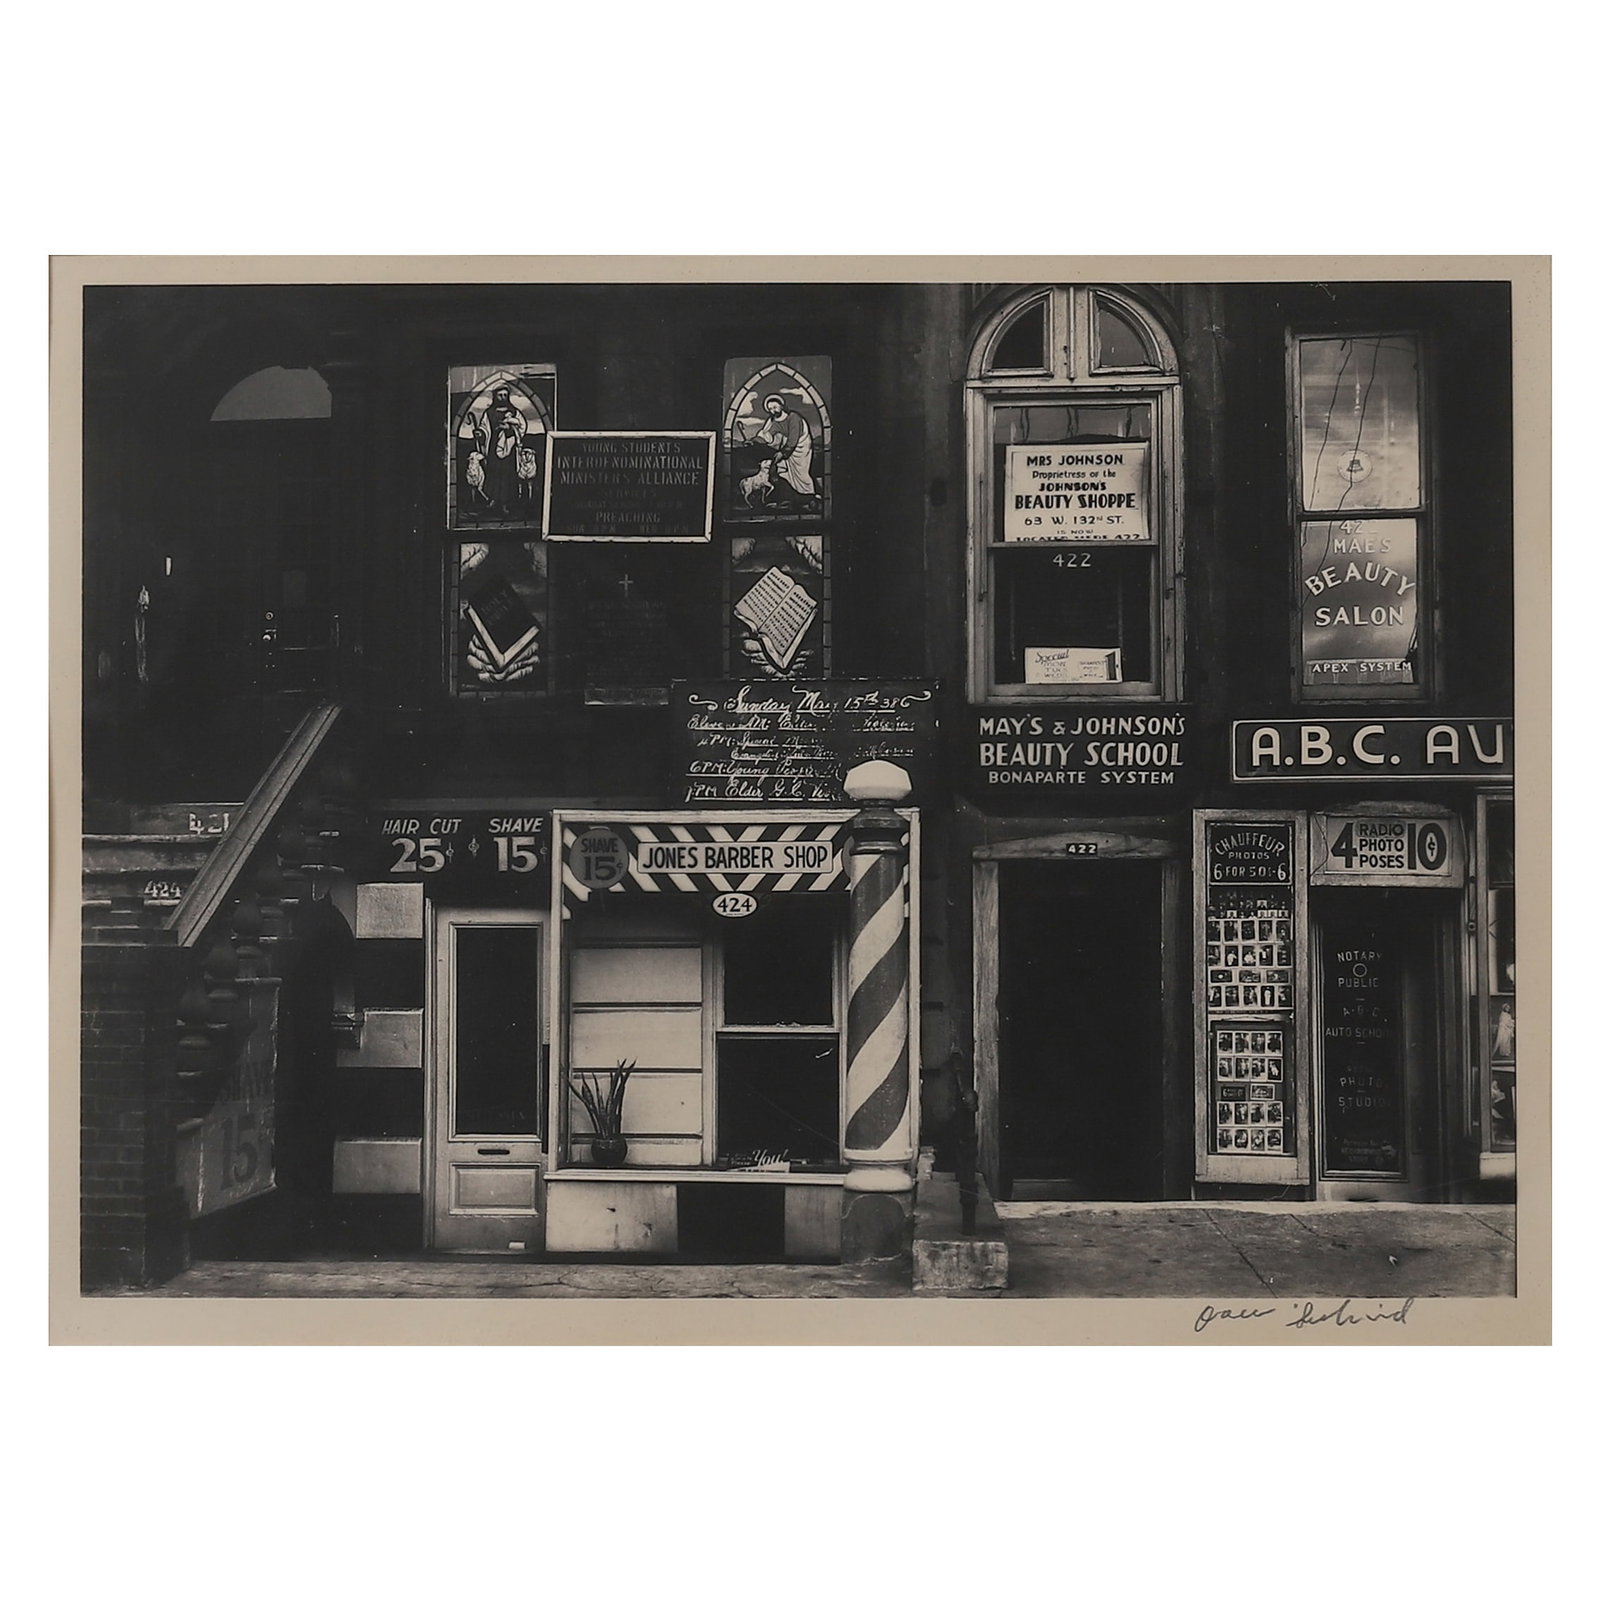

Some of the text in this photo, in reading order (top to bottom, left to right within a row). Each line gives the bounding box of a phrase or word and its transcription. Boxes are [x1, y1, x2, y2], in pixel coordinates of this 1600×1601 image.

[582, 441, 681, 453] YOUNG STUDENTS
[1027, 454, 1123, 466] MRS JOHNSON
[638, 471, 700, 485] ALLIANCE
[1032, 468, 1116, 481] Proprietress of the
[1015, 492, 1136, 509] BEAUTY SHOPPE
[596, 512, 660, 523] PREACHING
[1024, 515, 1043, 526] 63
[1051, 515, 1067, 525] W.
[1052, 552, 1092, 568] 422
[1304, 562, 1416, 597] BEAUTY
[1314, 605, 1404, 626] SALON
[1312, 661, 1413, 673] APEX SYSTEM
[724, 684, 791, 715] Sunday
[979, 712, 1185, 736] MAY'S & JOHNSON'S
[1251, 724, 1401, 767] A.B.C.
[979, 741, 1184, 767] BEAUTY SCHOOL
[988, 770, 1176, 785] BONAPARTE SYSTEM
[381, 819, 463, 835] HAIR CUT
[488, 817, 545, 834] SHAVE
[1359, 824, 1405, 837] RADIO
[580, 838, 619, 853] SHAVE
[1066, 843, 1098, 855] 422
[1214, 832, 1286, 857] CHAUFFEUR
[1330, 822, 1359, 869] 4
[1359, 839, 1405, 852] PHOTO
[643, 846, 829, 868] JONES BARBER SHOP
[1228, 851, 1271, 860] PHOTOS
[1359, 855, 1405, 869] POSES
[1213, 863, 1223, 880] 6
[1225, 866, 1246, 877] FOR
[144, 880, 183, 898] 424
[717, 896, 753, 913] 424
[1336, 951, 1382, 963] NOTARY
[1337, 977, 1380, 988] PUBLIC
[1325, 1026, 1353, 1038] AUTO
